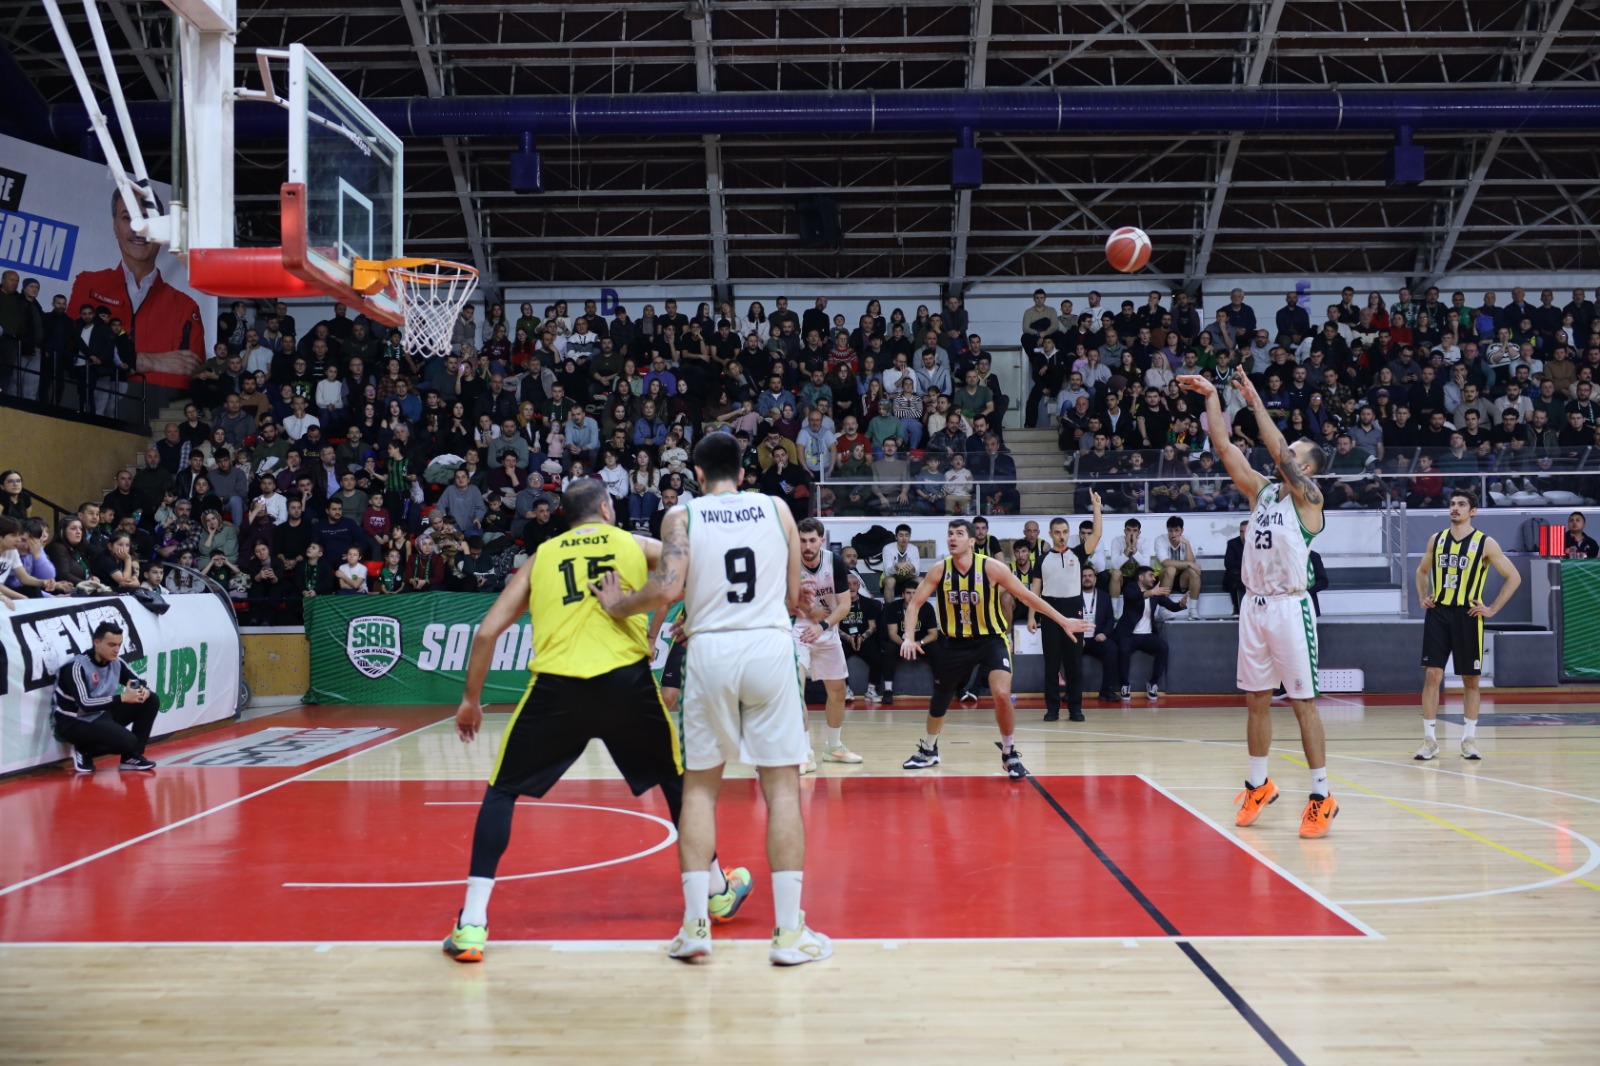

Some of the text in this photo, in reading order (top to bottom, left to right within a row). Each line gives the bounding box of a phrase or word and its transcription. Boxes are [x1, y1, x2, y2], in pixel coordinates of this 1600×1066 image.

[600, 288, 619, 316] D
[700, 506, 765, 524] YAVUZ KOÇA
[560, 534, 609, 548] AKSOY
[1254, 530, 1272, 549] 23
[1438, 554, 1469, 570] EGO
[558, 554, 615, 606] 15
[724, 546, 756, 604] 9
[1443, 573, 1458, 589] 12
[948, 590, 979, 605] EGO
[960, 609, 972, 625] 11
[352, 622, 396, 648] SBB
[155, 642, 208, 714] UP!
